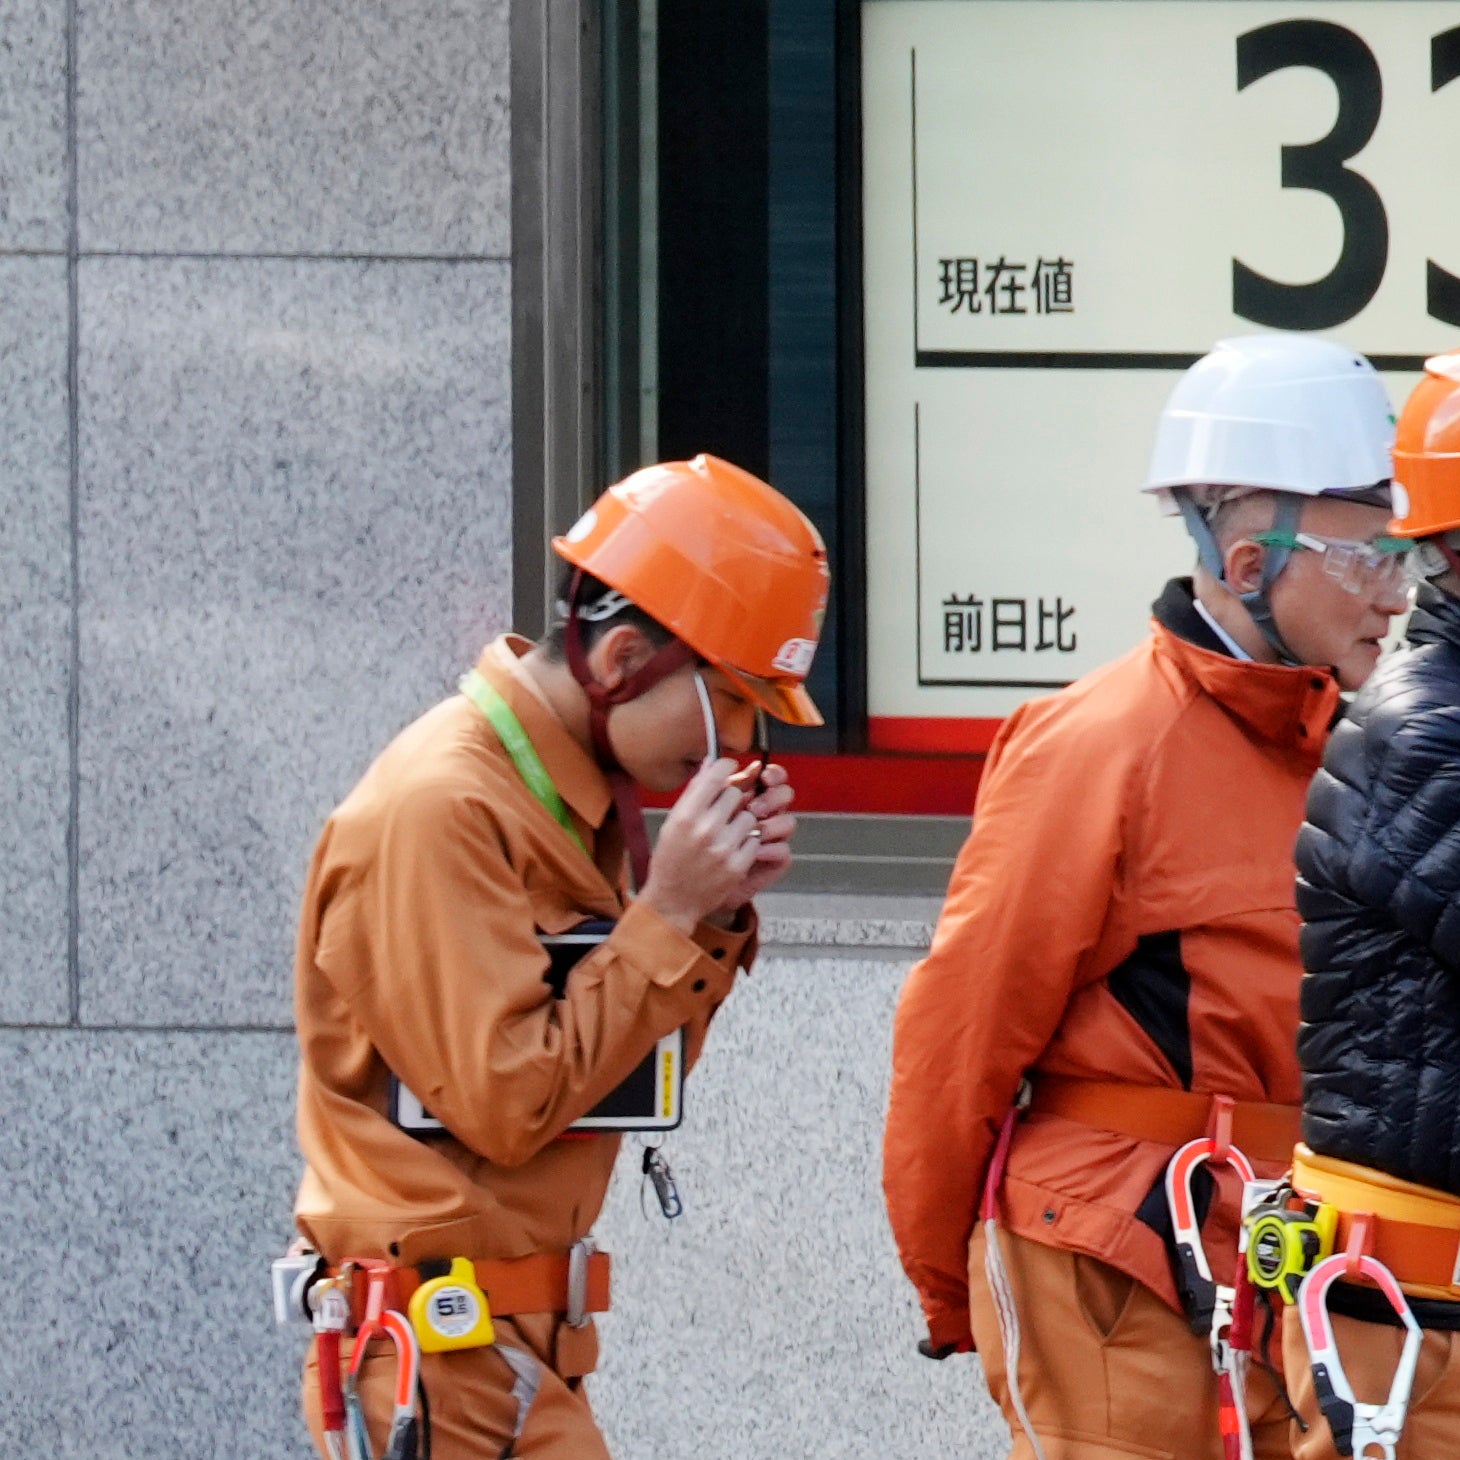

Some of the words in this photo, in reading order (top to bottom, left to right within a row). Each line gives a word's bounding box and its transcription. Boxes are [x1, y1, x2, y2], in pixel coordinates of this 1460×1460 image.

[938, 256, 1075, 315] 現在値
[942, 592, 1077, 652] 前日比
